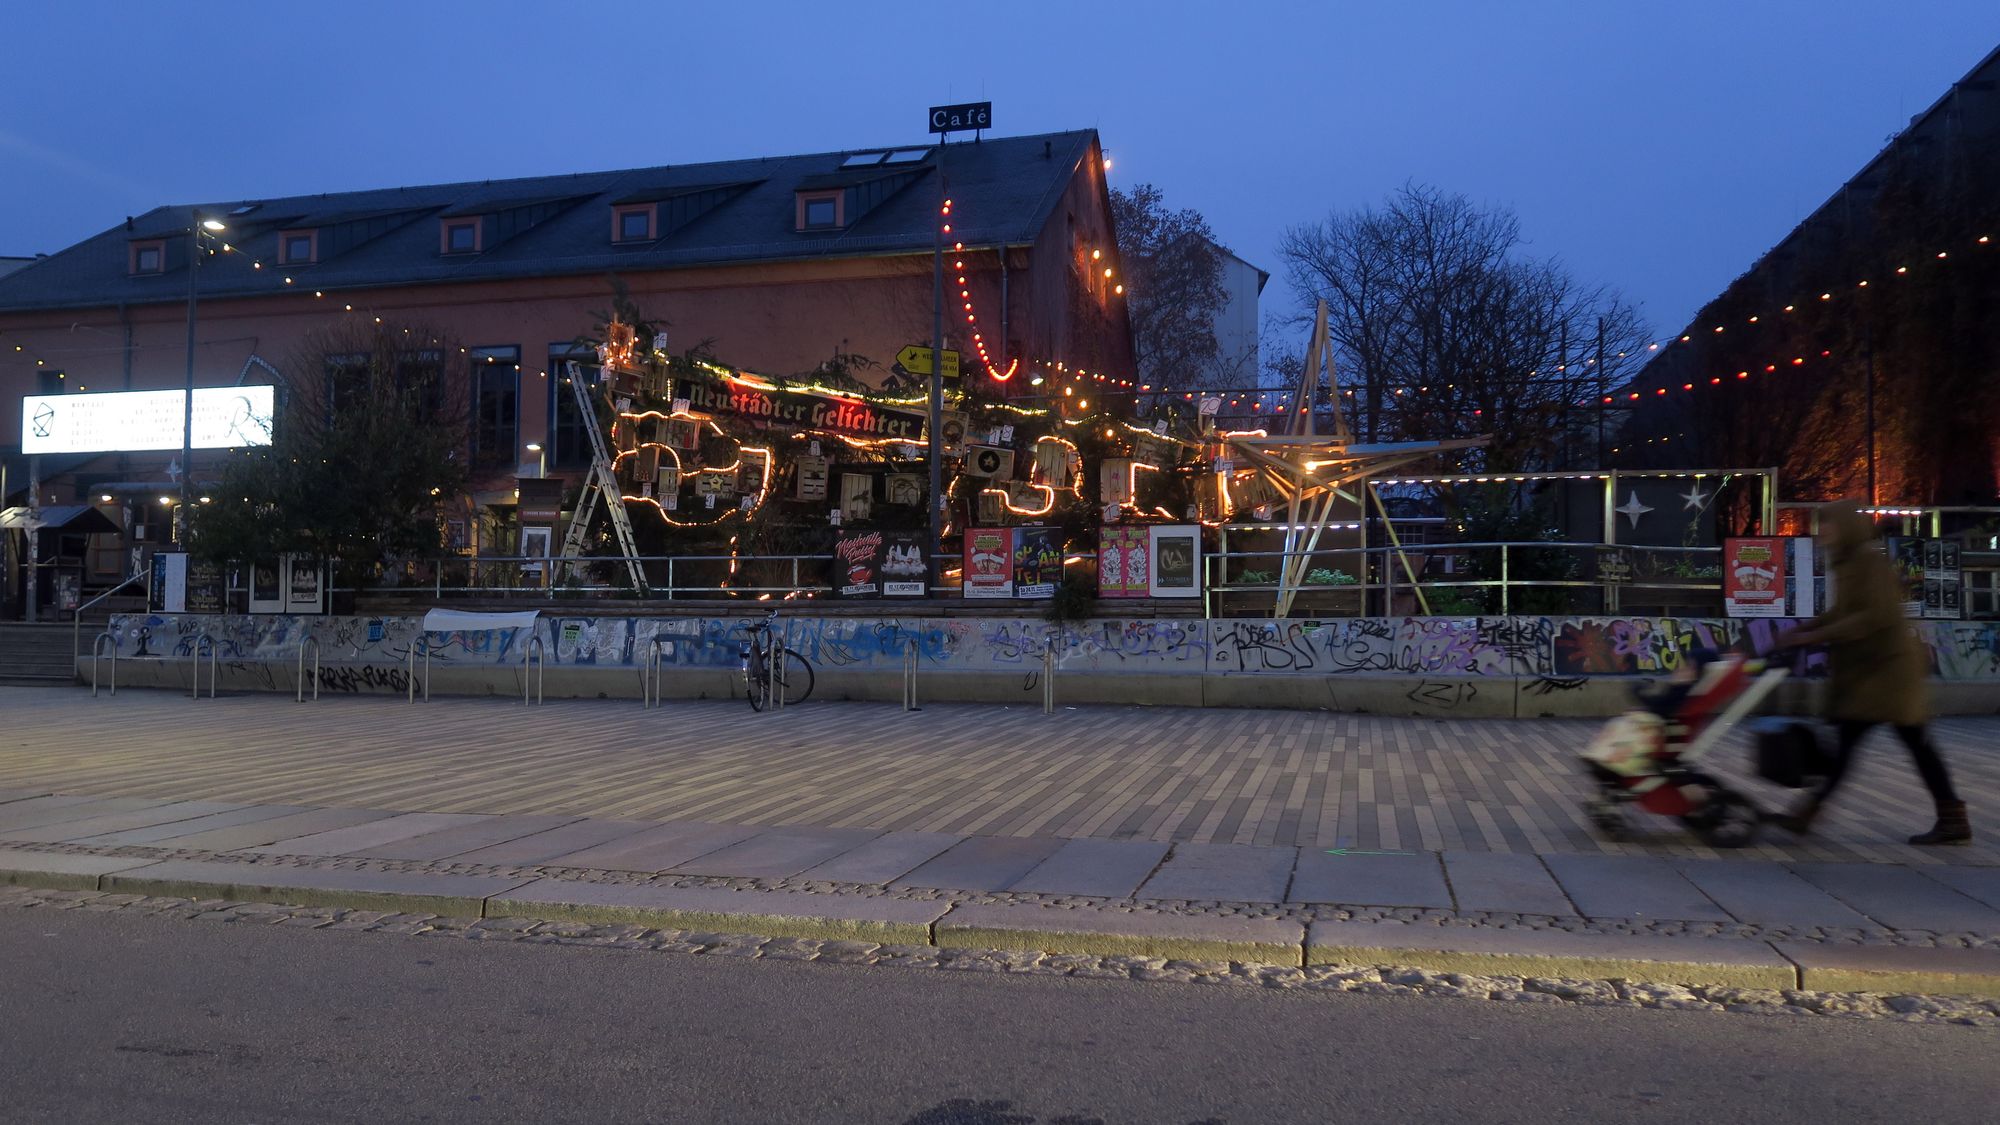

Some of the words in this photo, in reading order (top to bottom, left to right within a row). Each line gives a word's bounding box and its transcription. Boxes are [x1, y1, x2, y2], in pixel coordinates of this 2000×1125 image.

[933, 109, 986, 128] Café
[690, 383, 807, 421] Neustädter
[811, 402, 912, 436] Gelichter
